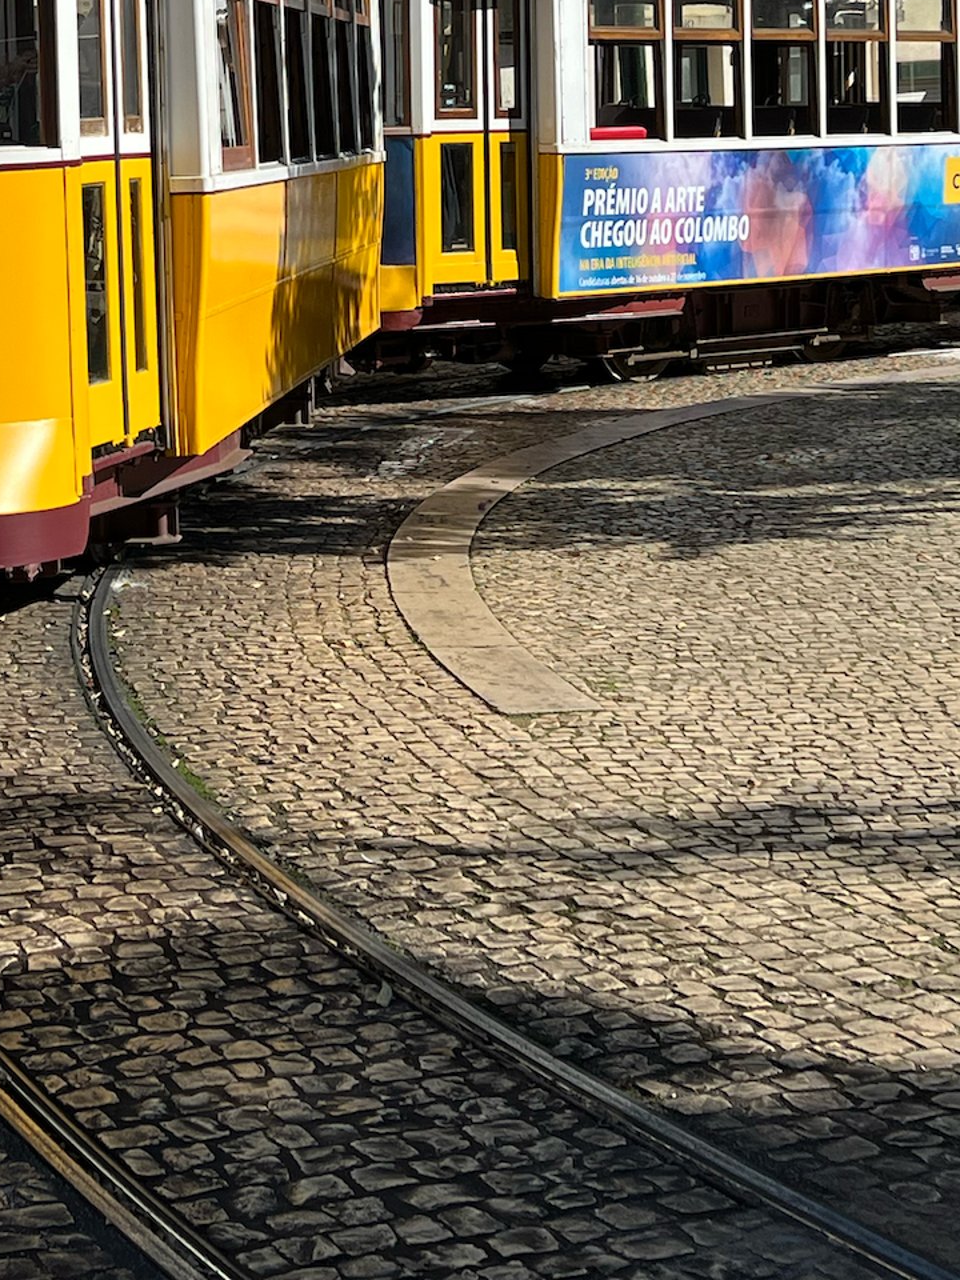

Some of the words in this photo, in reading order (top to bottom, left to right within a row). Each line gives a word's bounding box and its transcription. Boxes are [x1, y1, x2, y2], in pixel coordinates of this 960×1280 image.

[582, 182, 649, 217] PRÉMIO
[650, 186, 662, 213] A
[664, 185, 705, 213] ARTE
[580, 218, 648, 249] CHEGOU
[649, 217, 673, 246] AO
[674, 214, 750, 244] COLOMBO
